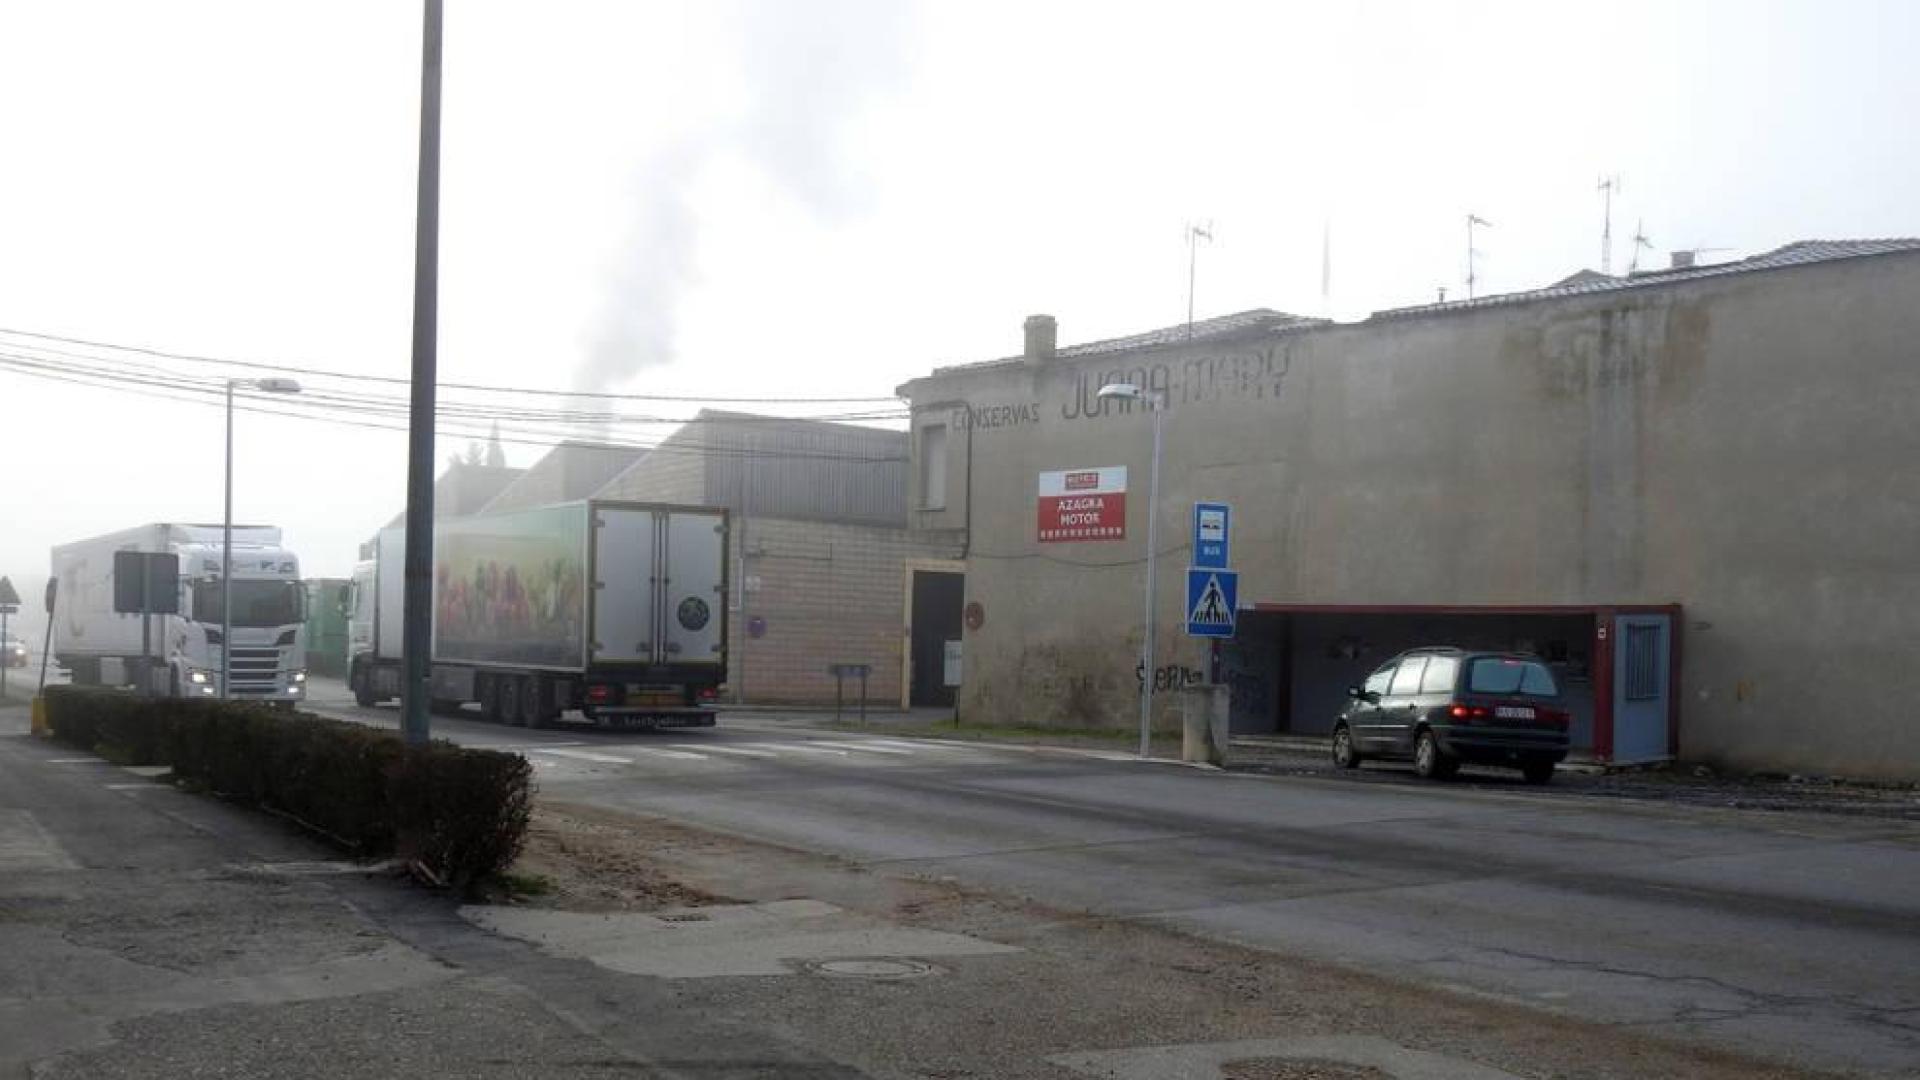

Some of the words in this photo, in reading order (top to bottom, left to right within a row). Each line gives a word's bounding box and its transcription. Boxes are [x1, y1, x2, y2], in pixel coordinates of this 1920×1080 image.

[952, 402, 1040, 430] CONSERVAS
[1057, 498, 1104, 512] AZAGRA
[1060, 513, 1100, 526] MOTOR
